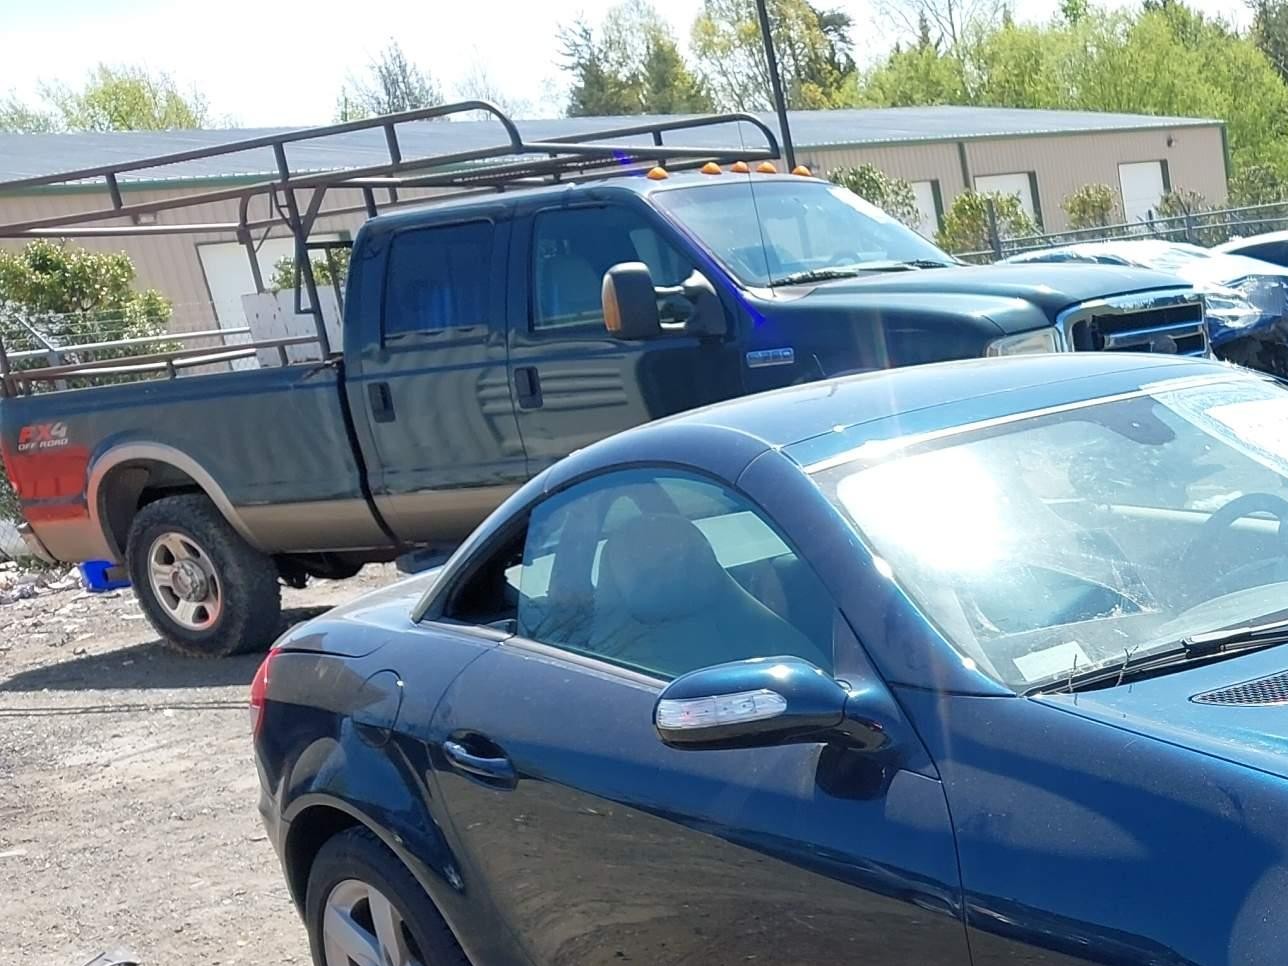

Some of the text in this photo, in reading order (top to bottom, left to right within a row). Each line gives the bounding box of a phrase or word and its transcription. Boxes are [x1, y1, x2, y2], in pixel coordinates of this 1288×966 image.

[19, 422, 67, 442] FX4
[18, 438, 68, 451] OFF ROAD
